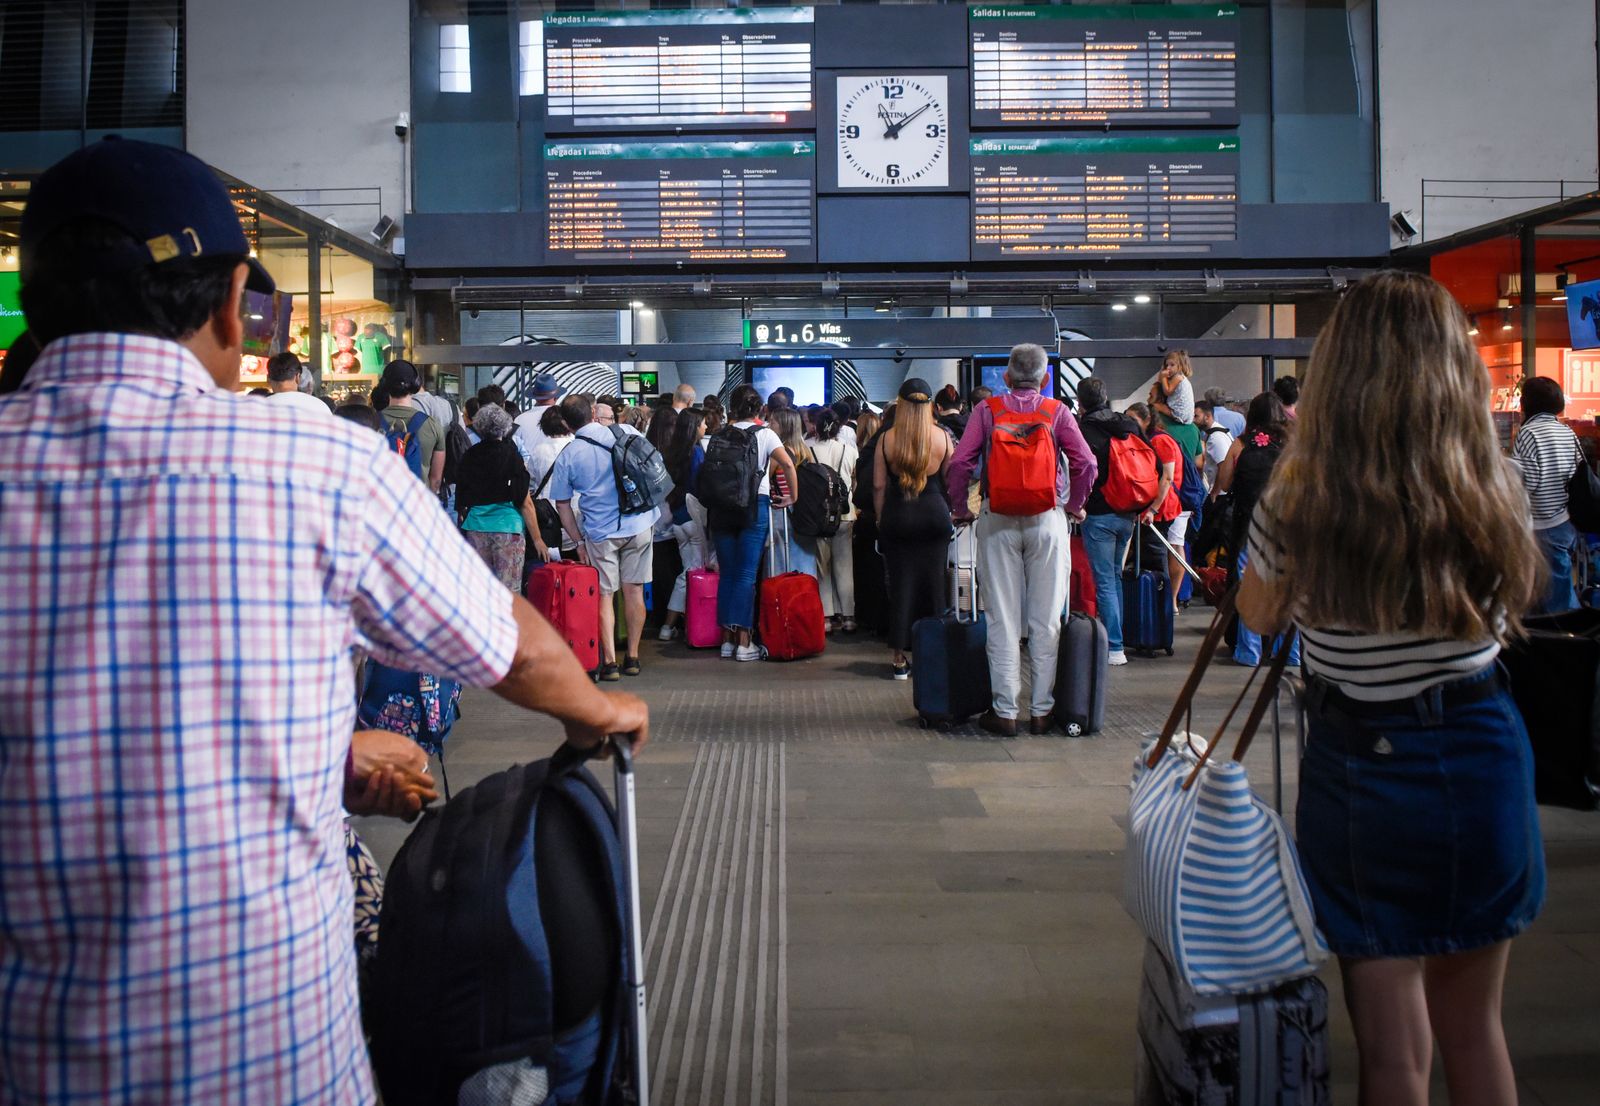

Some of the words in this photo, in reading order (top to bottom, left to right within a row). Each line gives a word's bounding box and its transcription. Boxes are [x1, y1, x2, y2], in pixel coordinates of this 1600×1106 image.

[546, 16, 581, 24] Llegadas
[881, 85, 903, 99] 12
[846, 125, 860, 139] 9
[926, 125, 939, 138] 3
[547, 148, 582, 157] Llegadas
[886, 164, 900, 178] 6
[775, 324, 786, 342] 1
[790, 334, 798, 342] a
[802, 324, 814, 343] 6
[820, 323, 841, 334] Vías
[644, 379, 651, 388] 4
